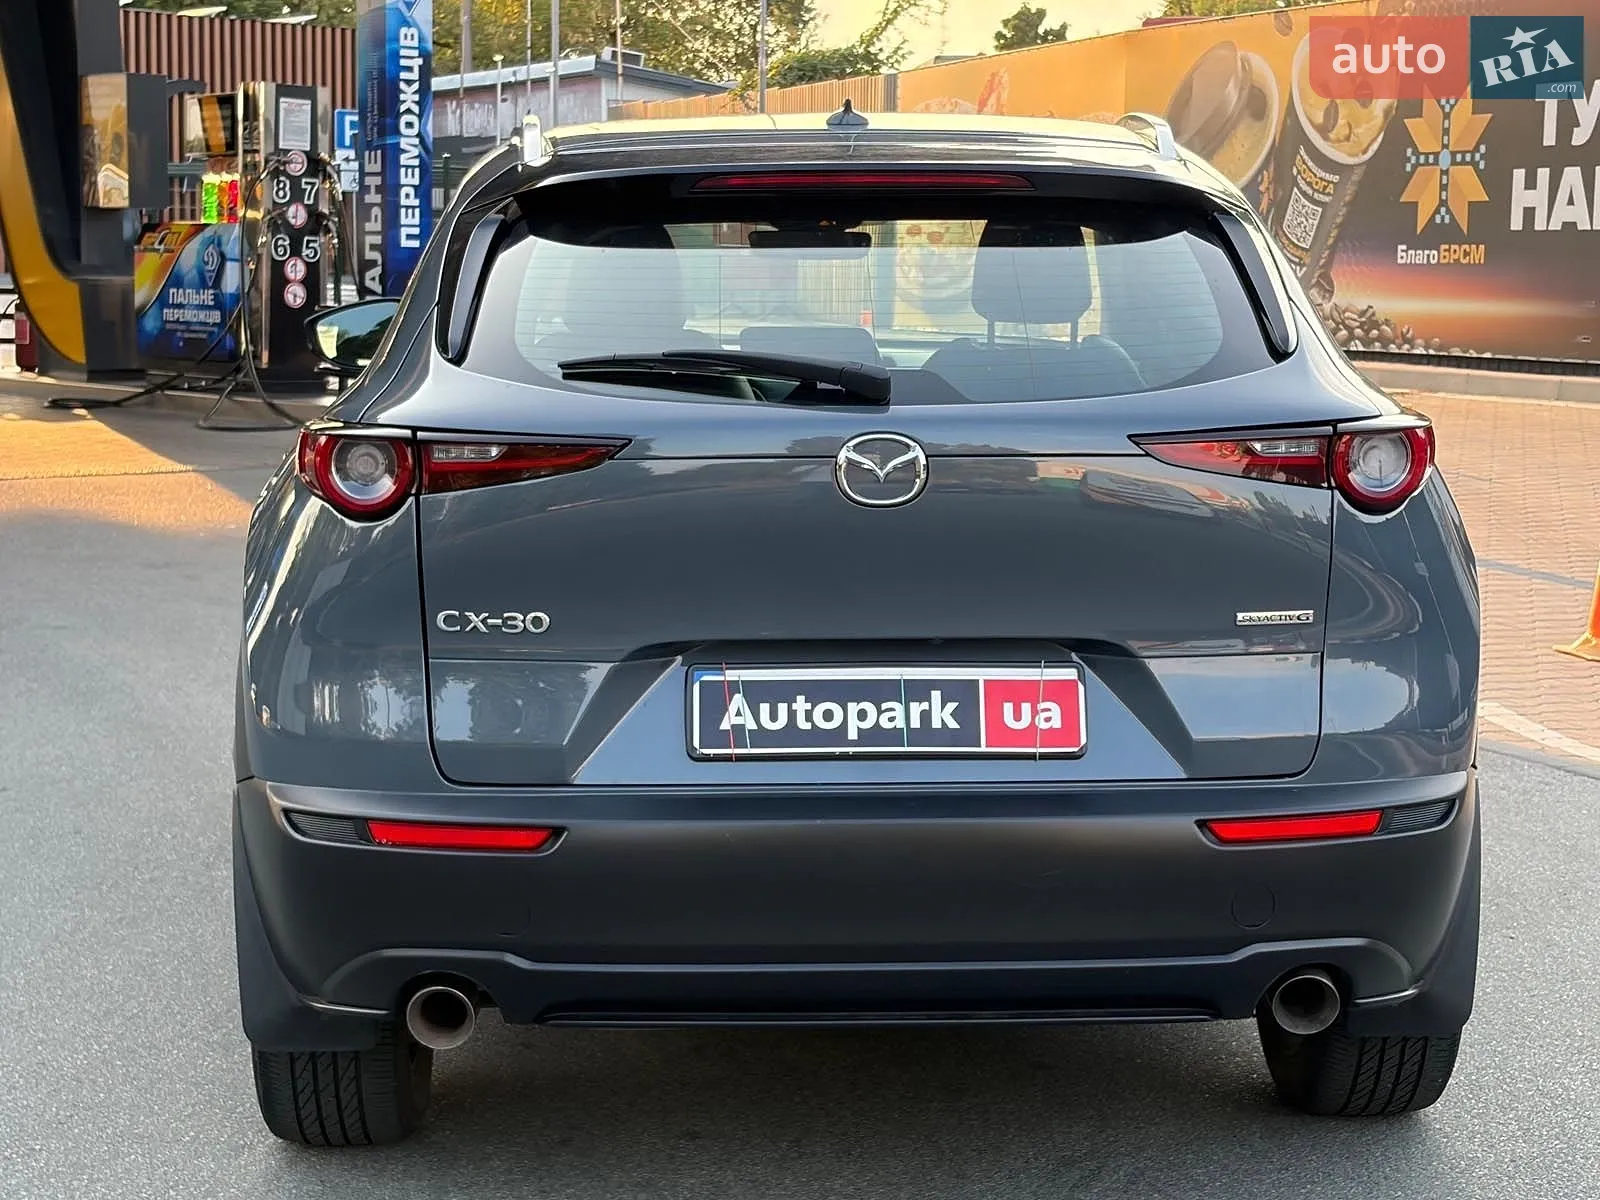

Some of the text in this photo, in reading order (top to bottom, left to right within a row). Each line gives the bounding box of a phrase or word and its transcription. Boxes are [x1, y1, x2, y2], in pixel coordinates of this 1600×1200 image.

[399, 26, 423, 249] ПЕРЕМОЖЦІВ
[272, 176, 319, 204] 8 7
[1510, 165, 1600, 232] НА
[364, 150, 382, 300] АЛЬНЕ
[271, 234, 321, 263] 6 5
[169, 287, 215, 305] ПАЛЬНЕ
[436, 610, 550, 633] CX-30
[719, 690, 1063, 740] Autopark ua
